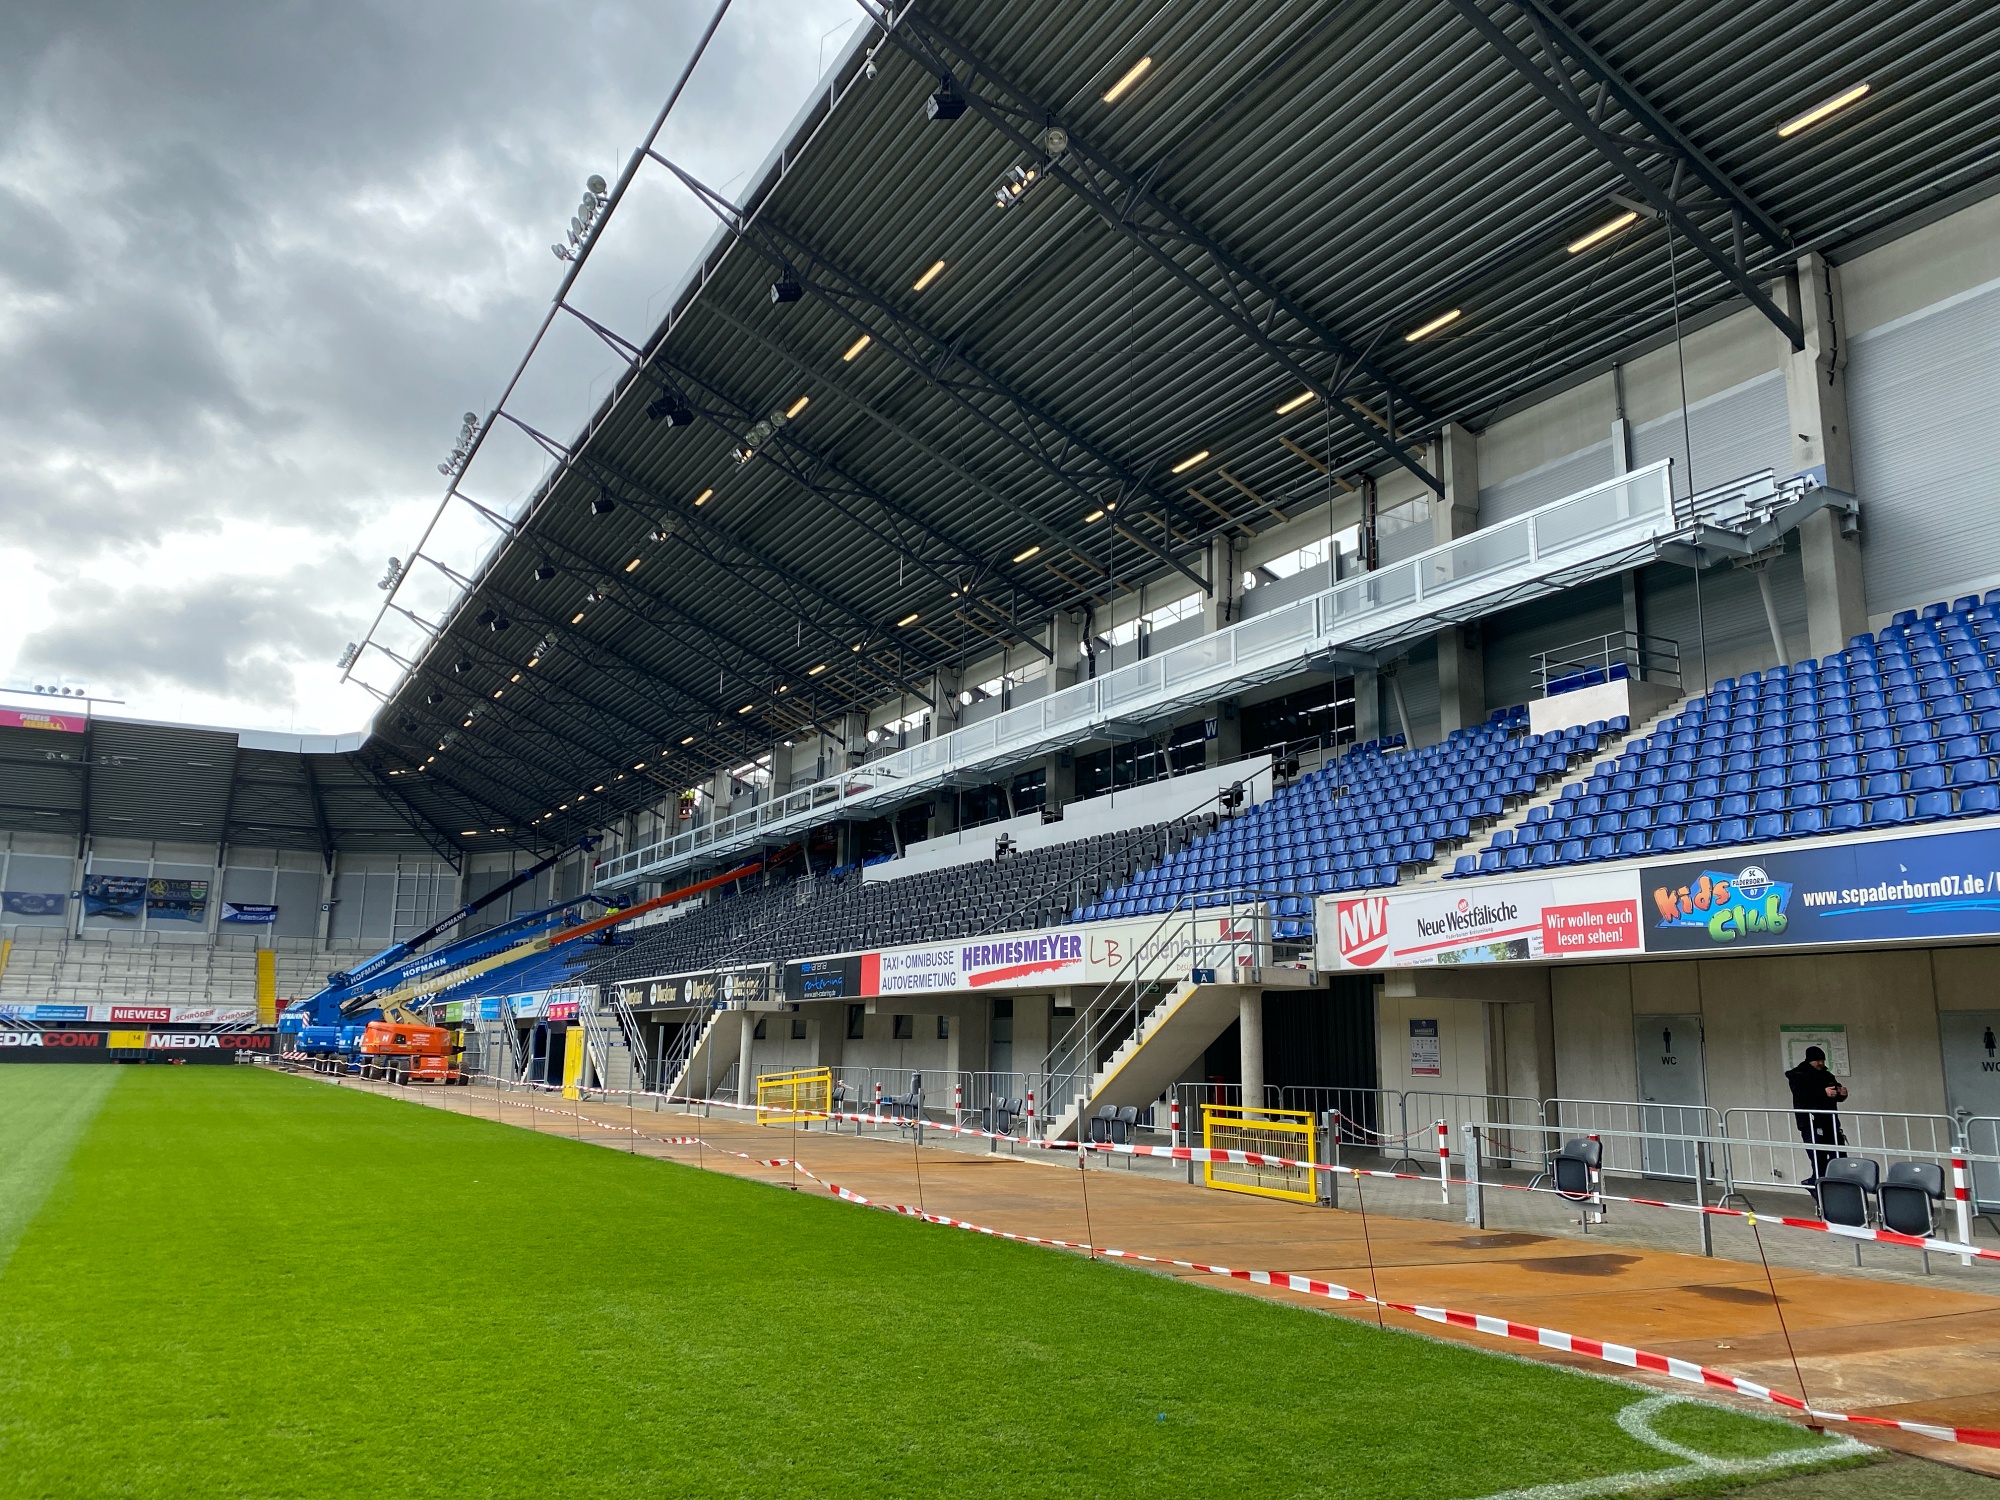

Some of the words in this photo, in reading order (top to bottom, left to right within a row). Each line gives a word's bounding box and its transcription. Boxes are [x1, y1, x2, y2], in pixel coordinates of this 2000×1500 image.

[1805, 473, 1820, 490] A
[19, 713, 50, 722] PREIS
[23, 720, 61, 731] REBELL
[1205, 720, 1217, 736] W
[929, 804, 934, 815] V
[1732, 877, 1764, 886] PADERBORN
[1803, 873, 1985, 907] www.scpaderborn07.de
[435, 911, 467, 934] HOFMANN
[1339, 896, 1385, 953] NW
[1417, 918, 1446, 937] Neue
[1445, 901, 1518, 931] Westfälische
[1546, 913, 1565, 929] Wir
[1567, 911, 1603, 928] wollen
[1607, 907, 1633, 925] euch
[1708, 894, 1788, 943] Club
[1557, 931, 1585, 946] lesen
[1588, 926, 1623, 944] sehen!
[962, 934, 1082, 972] HERMESMEYER
[1089, 935, 1122, 968] LB
[1129, 932, 1215, 961] Ladenbau
[402, 957, 446, 978] HOFMANN
[882, 957, 899, 971] TAXI
[905, 950, 954, 969] OMNIBUSSE
[1176, 962, 1194, 972] Desig
[350, 958, 386, 984] HOFMANN
[413, 967, 469, 995] HOFMANN
[881, 971, 956, 991] AUTOVERMIETUNG
[1200, 973, 1208, 982] A
[114, 1009, 167, 1020] NIEWELS
[175, 1009, 214, 1022] SCHRÖDER
[150, 1034, 271, 1048] MEDIACOM
[1661, 1056, 1677, 1066] WC
